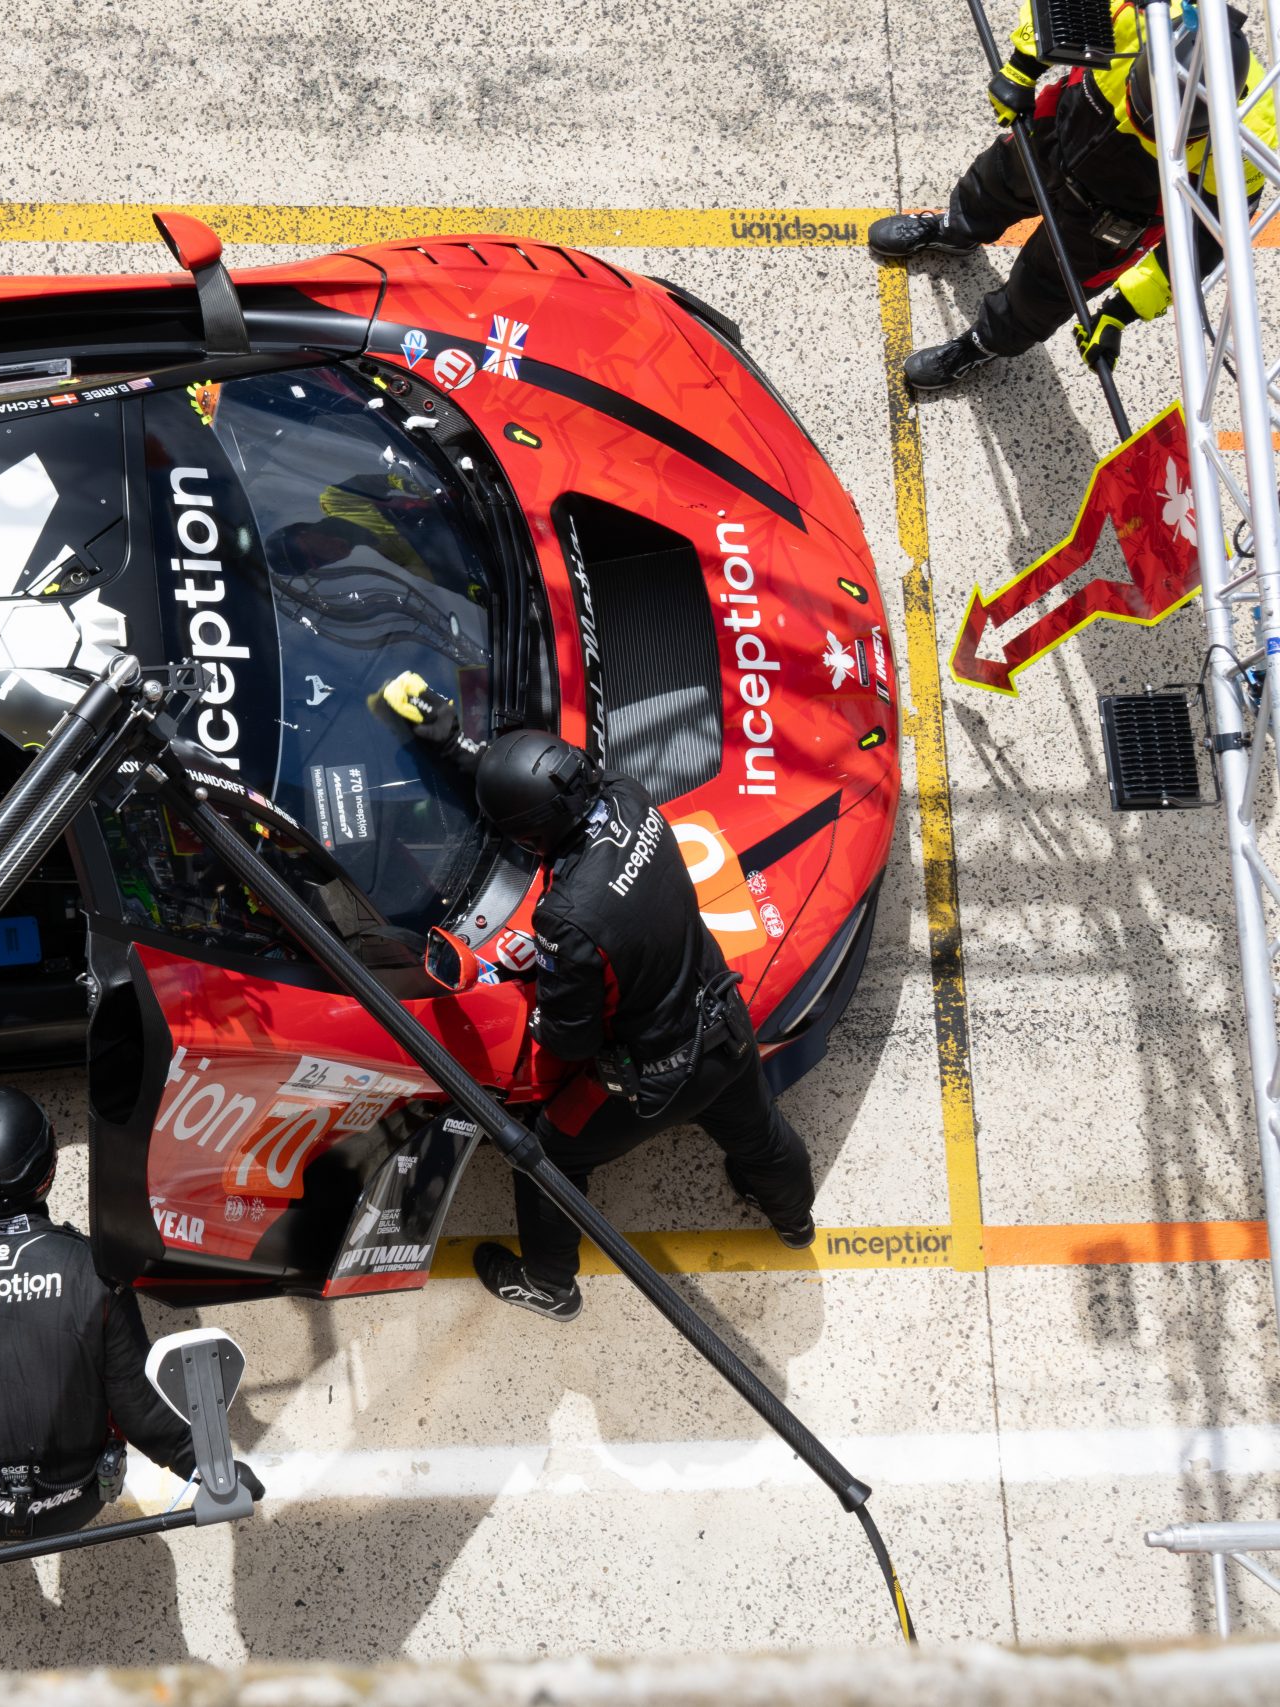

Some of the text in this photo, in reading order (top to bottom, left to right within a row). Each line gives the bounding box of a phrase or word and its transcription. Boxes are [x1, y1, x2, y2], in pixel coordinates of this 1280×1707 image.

[731, 215, 858, 243] inception
[81, 384, 131, 401] B.IRIBE
[716, 522, 781, 795] inception
[349, 768, 364, 793] #70
[332, 771, 348, 834] McLaren
[607, 806, 665, 897] inception
[342, 1101, 384, 1127] GT3
[235, 1101, 331, 1189] 70
[378, 1220, 396, 1228] BULL
[380, 1212, 400, 1221] SEAN
[377, 1226, 401, 1235] DESIGN
[338, 1244, 432, 1271] OPTIMUM
[372, 1262, 422, 1273] MOTORSPORT
